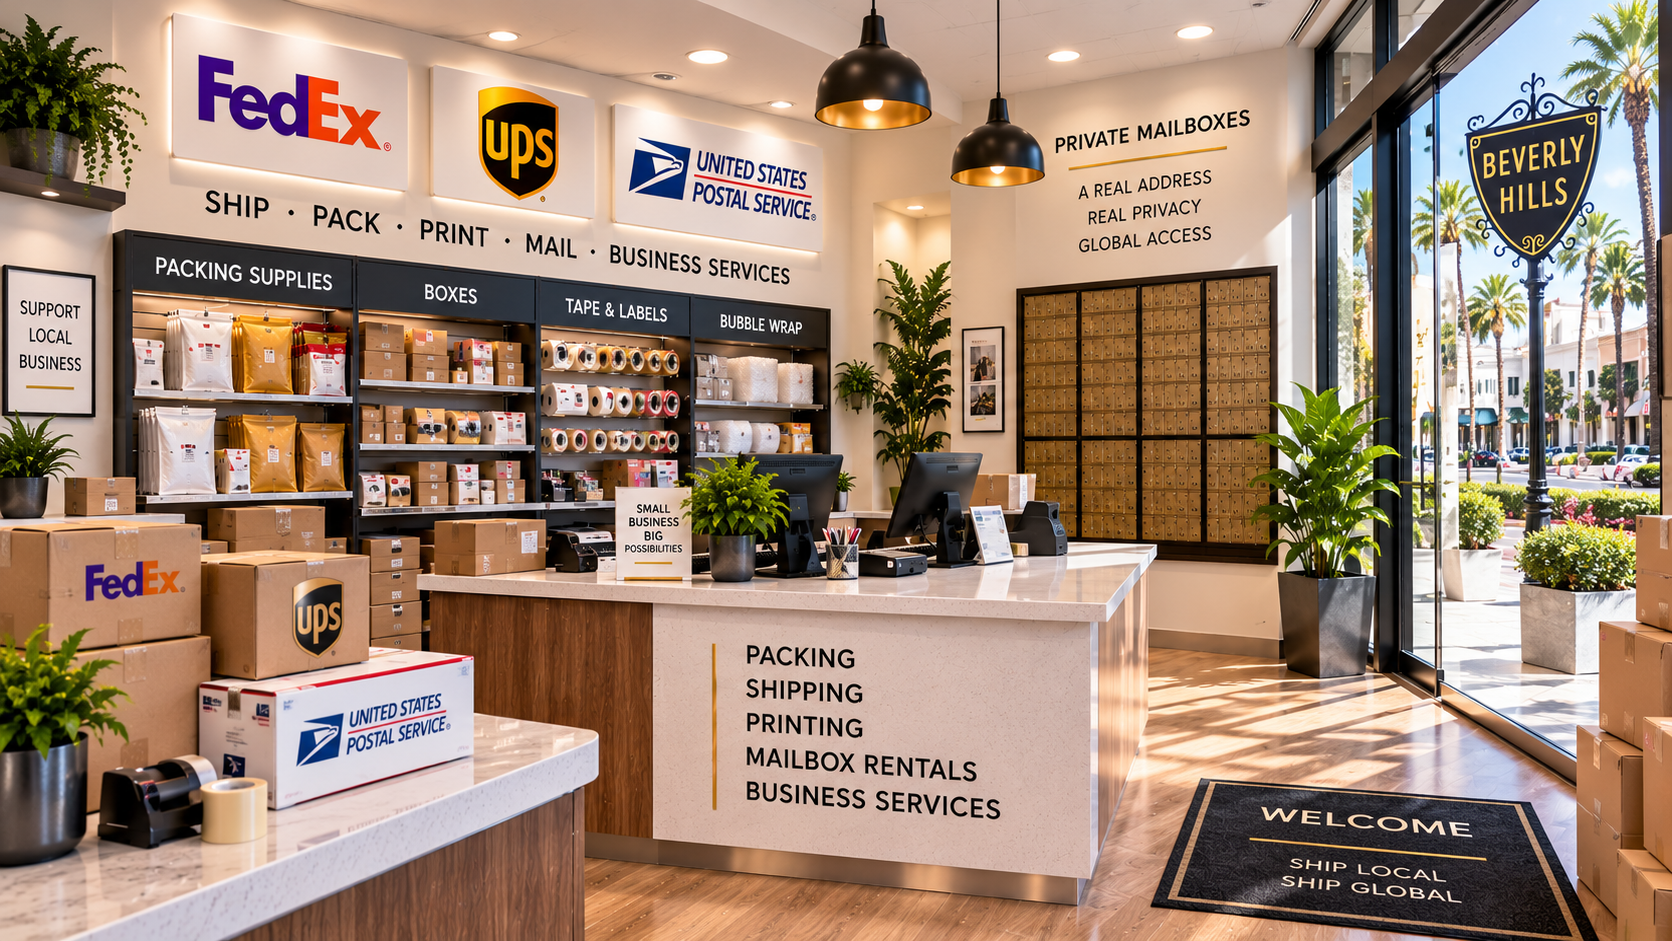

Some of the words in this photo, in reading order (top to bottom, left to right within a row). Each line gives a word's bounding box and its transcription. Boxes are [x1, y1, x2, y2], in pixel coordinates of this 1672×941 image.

[198, 54, 382, 151] FedEx
[1055, 126, 1130, 154] PRIVATE
[1137, 109, 1251, 142] MAILBOXES
[696, 150, 755, 181] UNITED
[757, 163, 808, 191] STATES
[1482, 134, 1586, 180] BEVERLY
[1078, 185, 1089, 200] A
[1094, 180, 1133, 198] REAL
[1137, 169, 1212, 193] ADDRESS
[1499, 176, 1569, 214] HILLS
[692, 182, 751, 212] POSTAL
[753, 193, 812, 221] SERVICE
[1088, 207, 1127, 226] REAL
[1132, 198, 1202, 221] PRIVACY
[205, 190, 270, 219] SHIP
[313, 204, 381, 235] PACK
[420, 218, 489, 248] PRINT
[526, 232, 578, 259] MAIL
[609, 244, 702, 275] BUSINESS
[708, 258, 790, 285] SERVICES
[1078, 233, 1142, 253] GLOBAL
[1146, 225, 1212, 247] ACCESS
[155, 256, 243, 283] PACKING
[249, 266, 333, 291] SUPPLIES
[424, 283, 478, 305] BOXES
[20, 299, 81, 320] SUPPORT
[565, 297, 600, 316] TAPE
[604, 302, 615, 318] &
[619, 303, 668, 323] LABELS
[720, 313, 766, 332] BUBBLE
[768, 318, 803, 335] WRAP
[29, 327, 73, 346] LOCAL
[19, 353, 82, 372] BUSINESS
[628, 516, 680, 527] BUSINESS
[636, 503, 671, 514] SMALL
[644, 530, 663, 542] BIG
[85, 560, 181, 602] FedEx
[746, 644, 855, 669] PACKING
[746, 678, 863, 704] SHIPPING
[349, 702, 398, 728] UNITED
[399, 693, 442, 717] STATES
[346, 728, 395, 755] POSTAL
[397, 715, 447, 742] SERVICE
[746, 712, 863, 739] PRINTING
[746, 746, 855, 774] MAILBOX
[864, 754, 977, 782] RENTALS
[746, 780, 866, 810] BUSINESS
[875, 790, 1001, 820] SERVICES
[1260, 806, 1474, 839] WELCOME
[1289, 858, 1347, 873] SHIP
[1357, 863, 1447, 883] LOCAL
[1280, 875, 1341, 891] SHIP
[1351, 880, 1462, 904] GLOBAL
